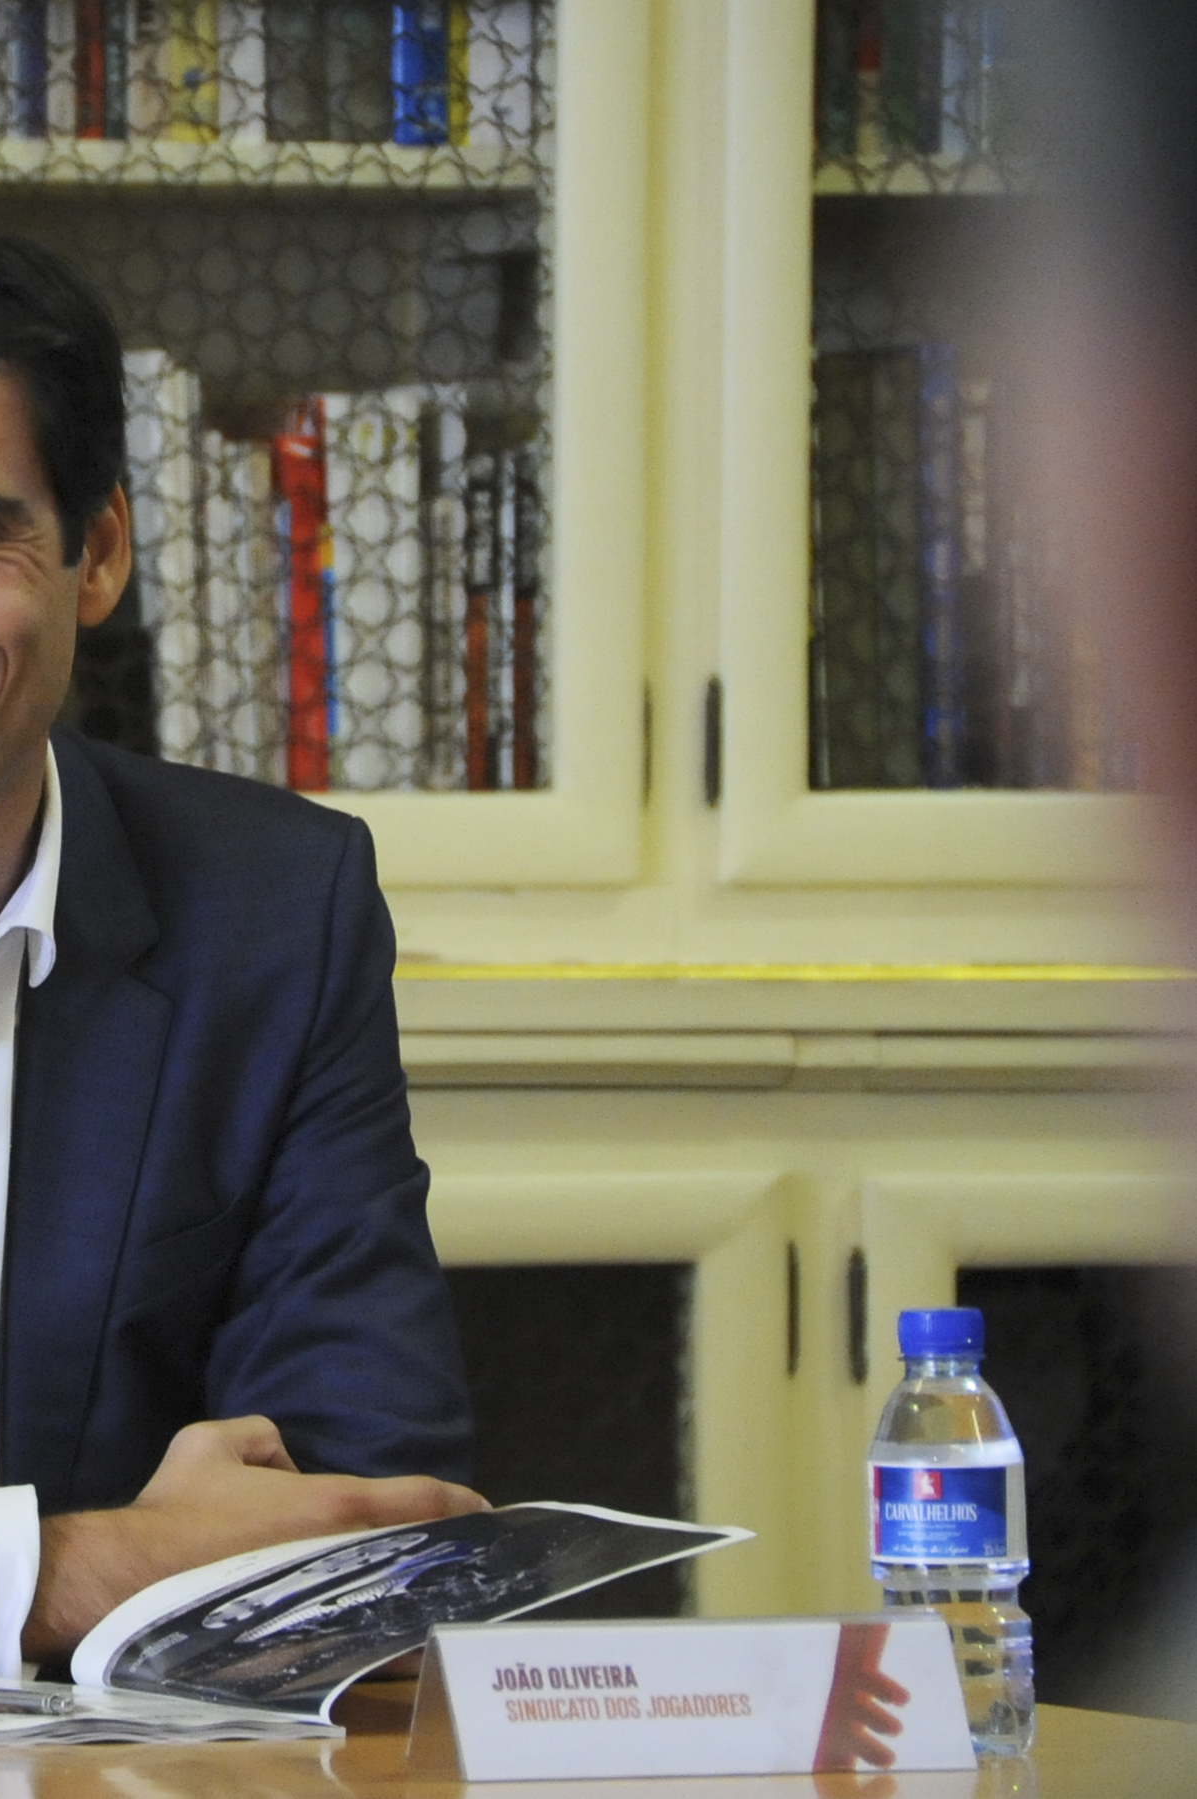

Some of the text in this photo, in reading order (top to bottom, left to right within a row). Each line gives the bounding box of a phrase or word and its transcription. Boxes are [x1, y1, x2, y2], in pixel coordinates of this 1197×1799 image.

[885, 1502, 977, 1522] CARVALHELHOS
[492, 1662, 638, 1691] JOÃO OLIVEIRA
[506, 1693, 752, 1722] SINDICATO DOS JOGADORES
